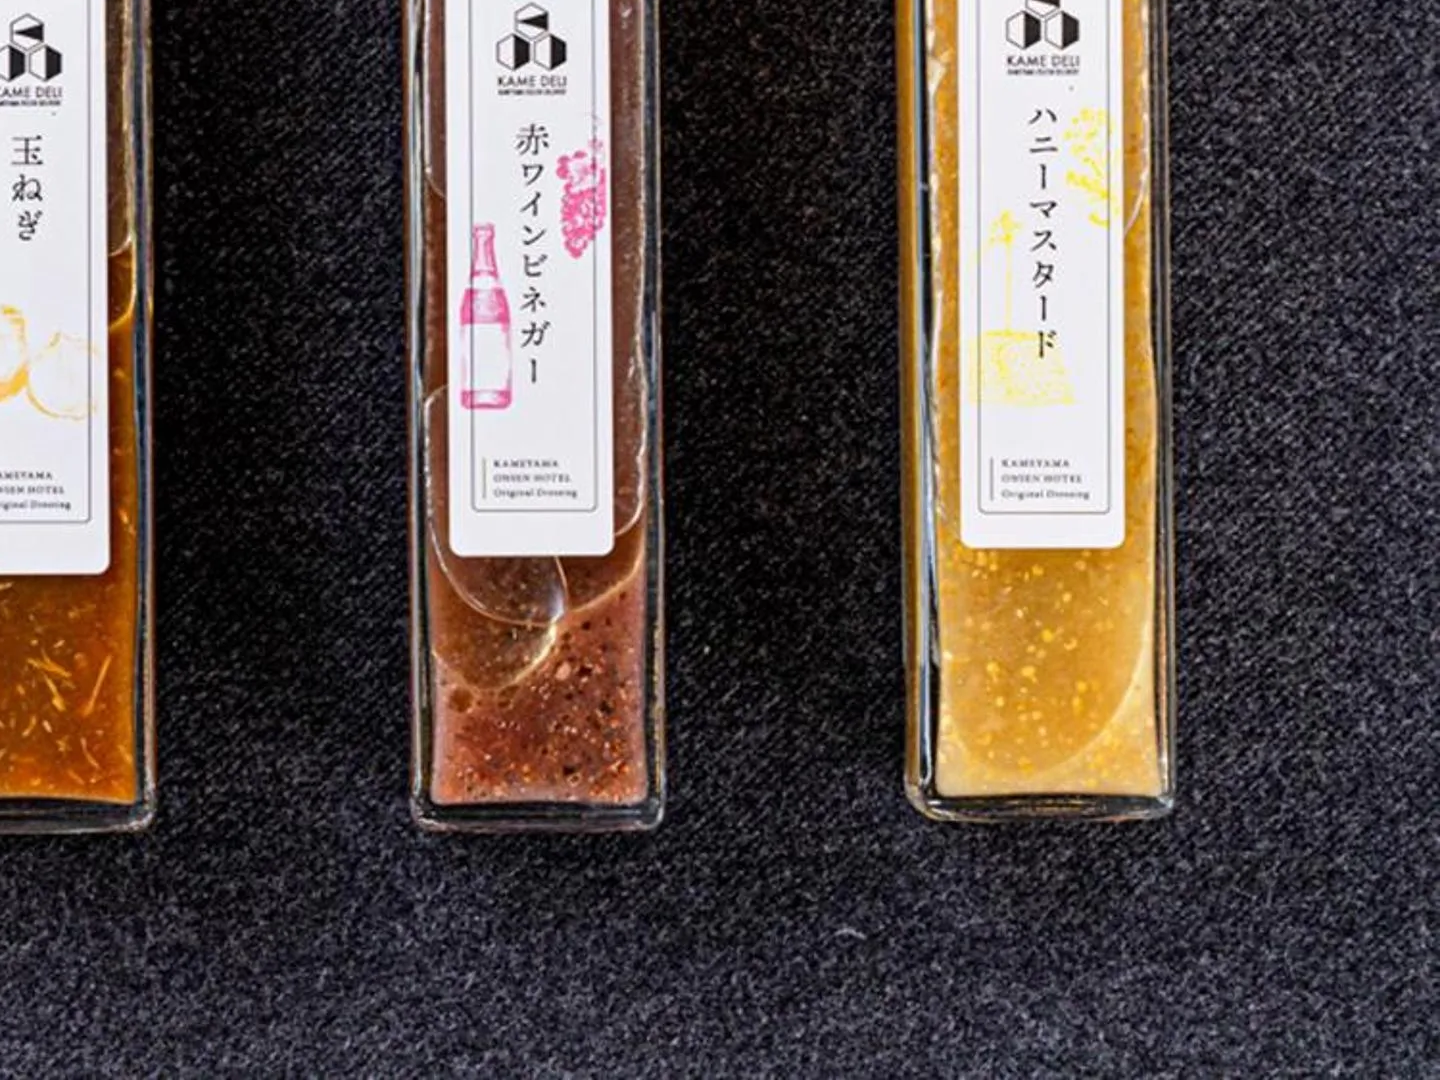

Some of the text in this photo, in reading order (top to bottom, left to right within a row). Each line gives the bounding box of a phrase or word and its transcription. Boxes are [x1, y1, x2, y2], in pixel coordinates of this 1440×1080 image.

[1007, 55, 1080, 67] KAME DELI
[497, 75, 568, 88] KAME DELI
[35, 86, 63, 98] DELI
[11, 134, 44, 242] 玉ねぎ
[1028, 108, 1059, 359] ハニーマスタード
[515, 123, 551, 383] 赤ワインビネガー
[493, 460, 558, 468] KAMEYAMA
[1001, 459, 1069, 468] KAMEYAMA
[533, 473, 571, 482] HOTEL
[1043, 474, 1081, 483] HOTEL
[27, 485, 64, 494] HOTEL
